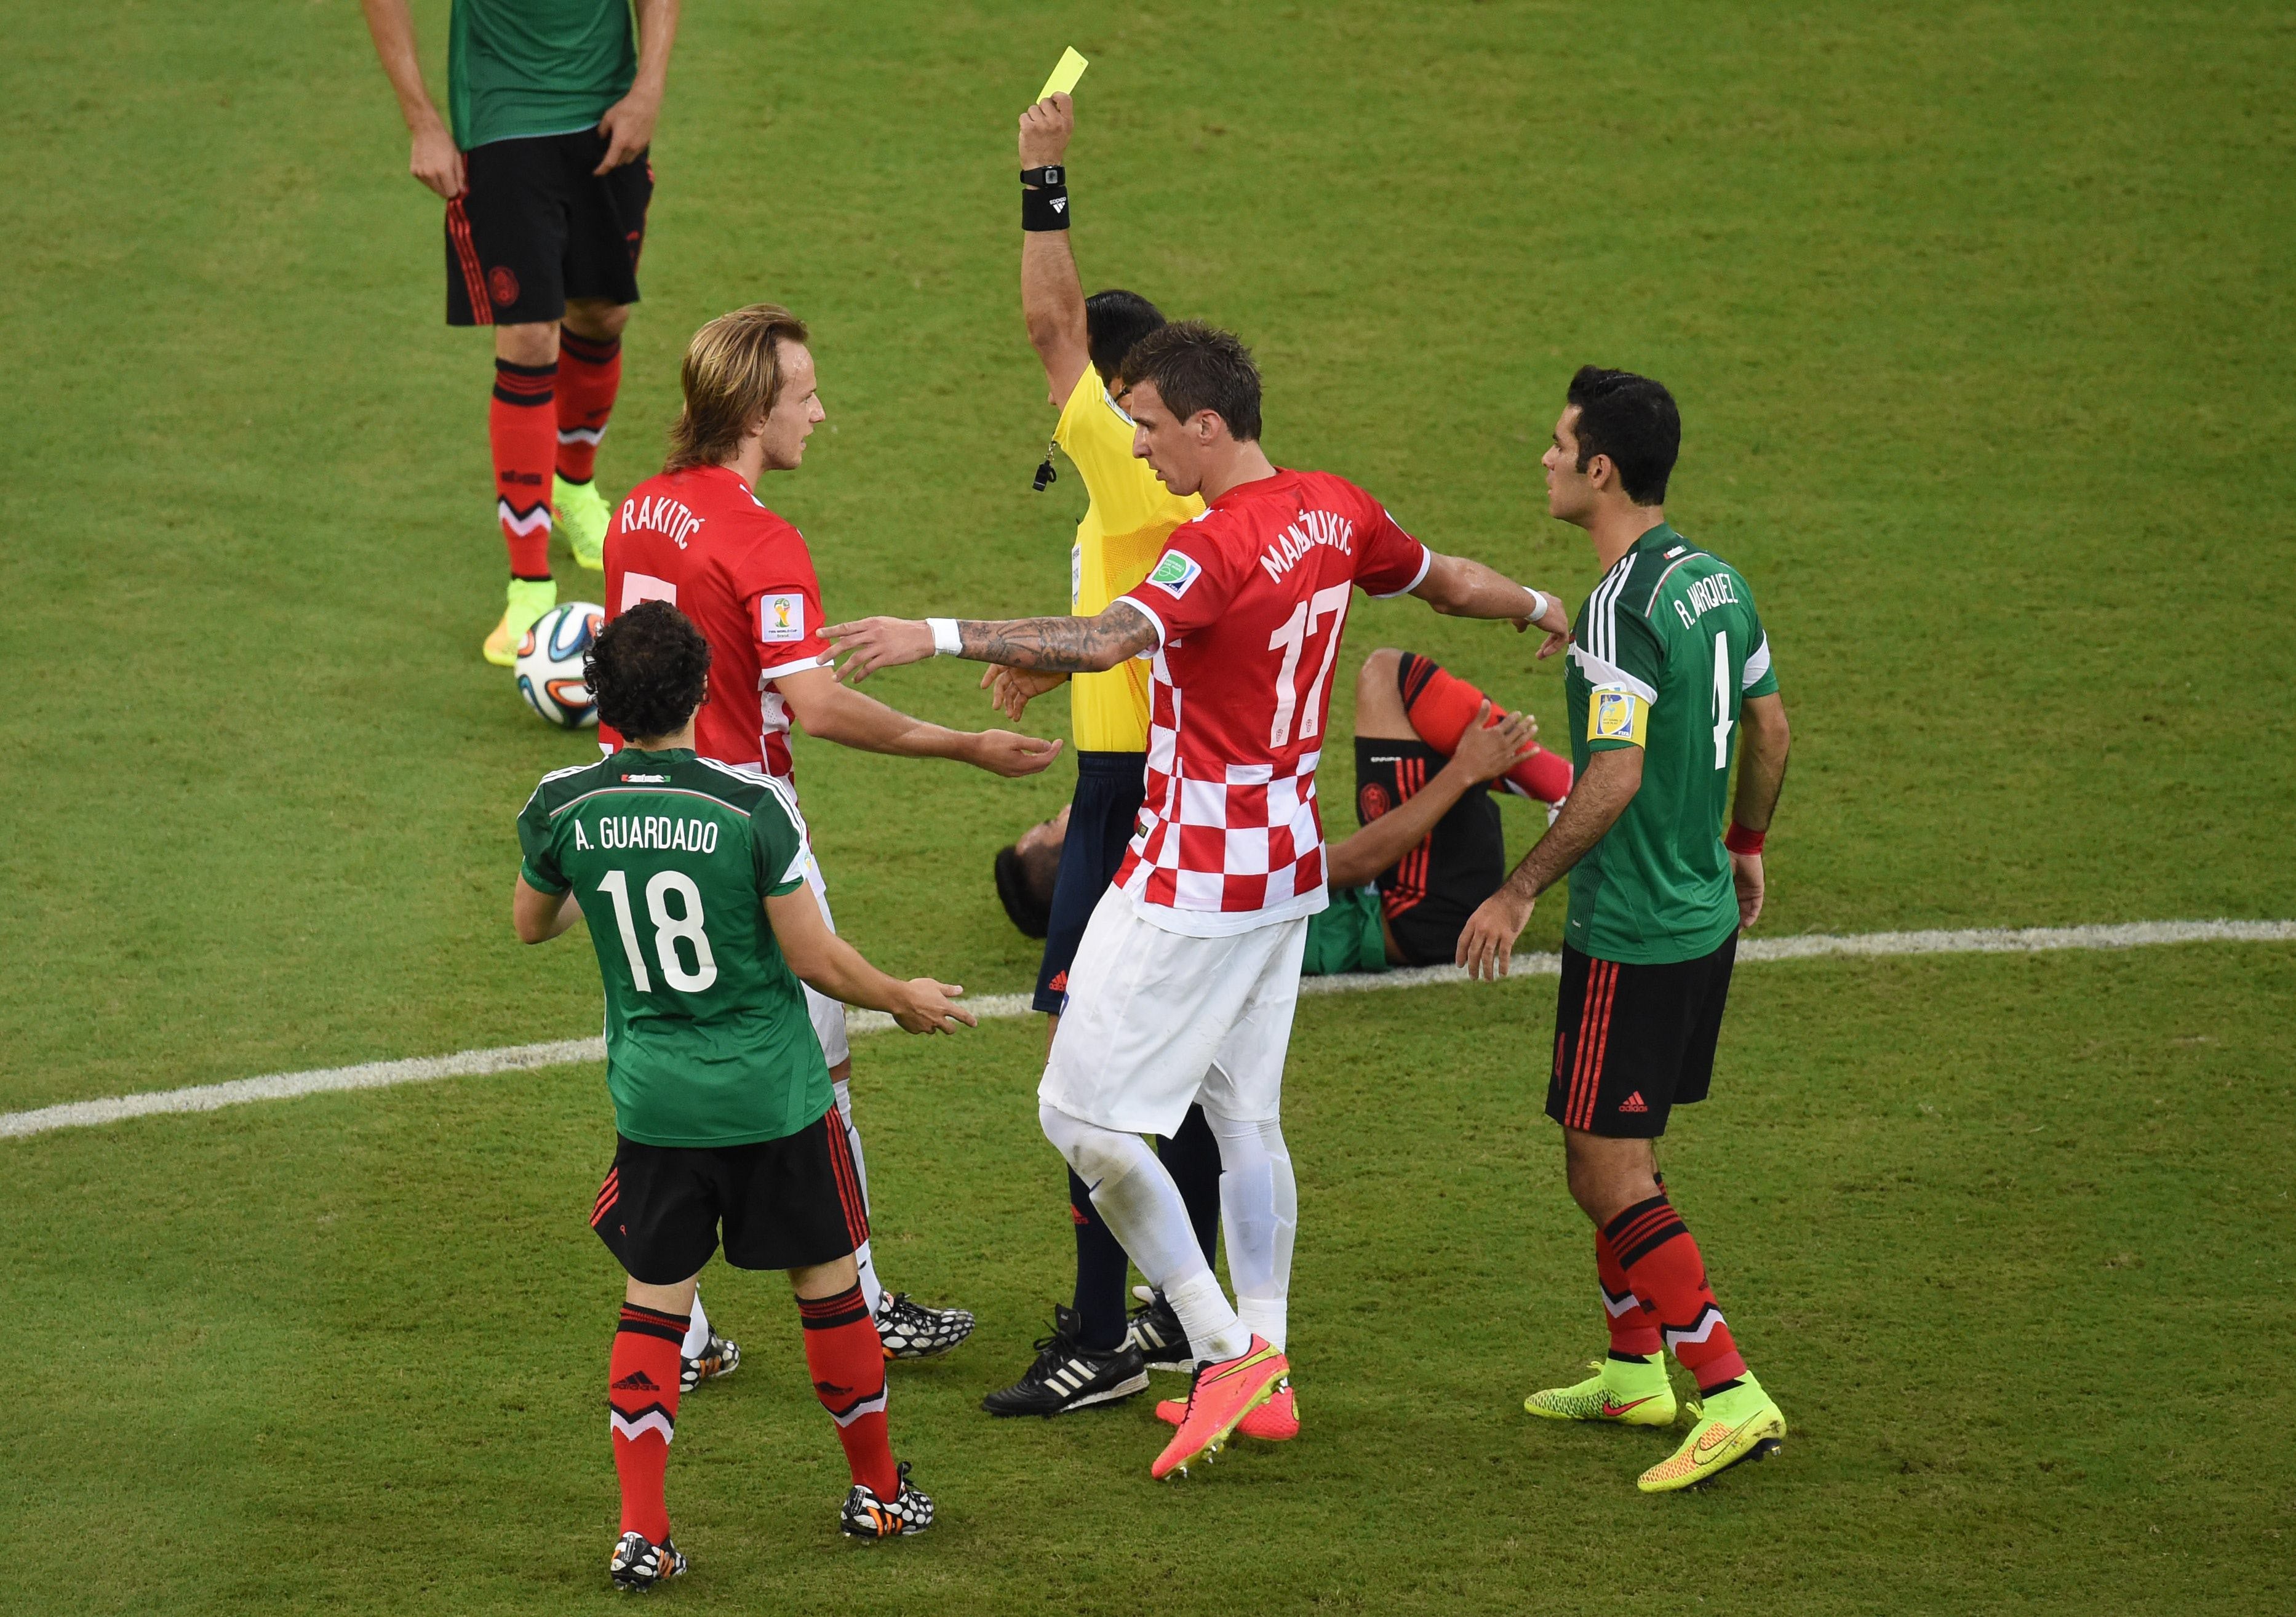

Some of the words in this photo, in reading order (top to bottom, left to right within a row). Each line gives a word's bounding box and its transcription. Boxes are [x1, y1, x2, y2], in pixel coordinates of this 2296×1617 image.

[621, 495, 706, 549] RAKITIĆ
[1673, 599, 1696, 630] R.
[1268, 579, 1351, 749] 17
[1712, 631, 1734, 770] 4
[574, 819, 595, 851] A.
[599, 816, 719, 854] GUARDADO
[596, 870, 718, 993] 18
